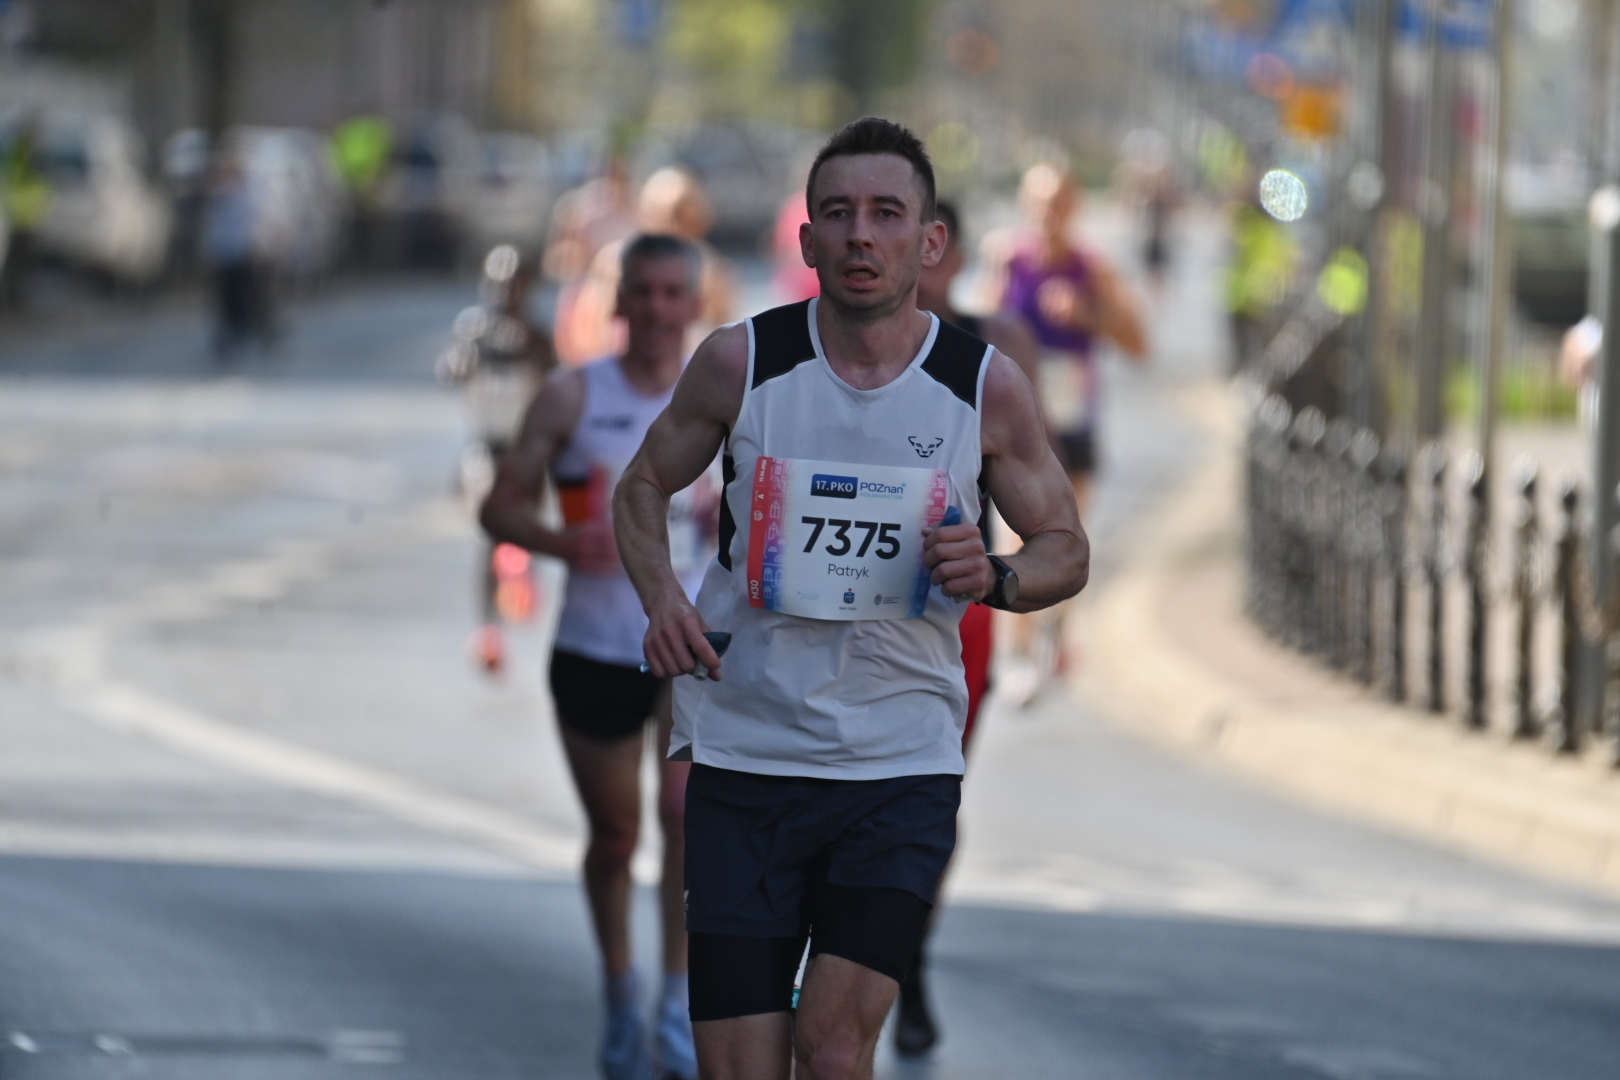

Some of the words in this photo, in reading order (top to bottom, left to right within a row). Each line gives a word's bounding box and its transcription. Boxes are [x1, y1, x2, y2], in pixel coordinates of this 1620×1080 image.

[815, 480, 854, 492] 17.PKO
[802, 516, 901, 560] 7375
[828, 564, 869, 580] Patryk
[750, 580, 760, 600] M30
